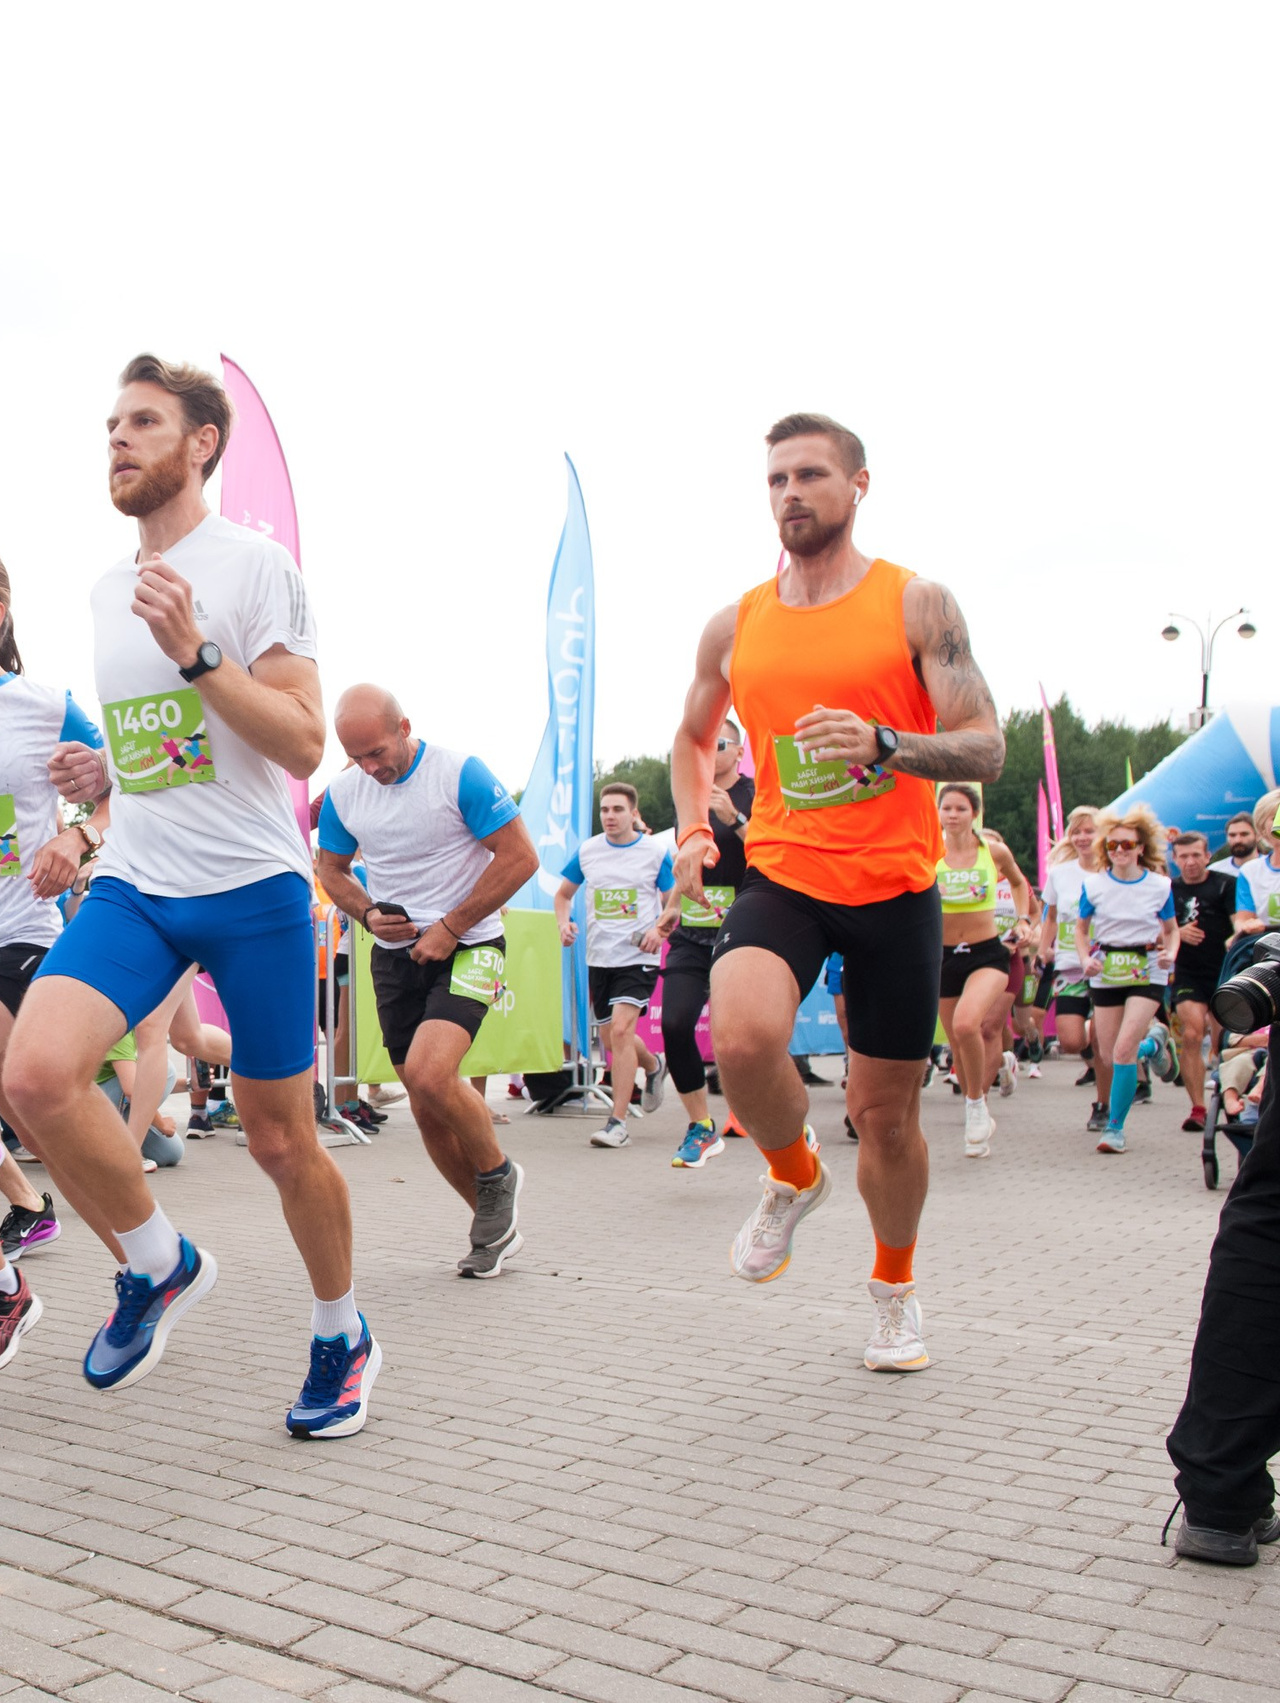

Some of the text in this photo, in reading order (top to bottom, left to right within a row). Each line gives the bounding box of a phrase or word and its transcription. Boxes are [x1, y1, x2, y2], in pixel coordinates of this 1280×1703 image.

[112, 699, 182, 737] 1460
[944, 870, 980, 884] 1296
[600, 890, 629, 902] 1243
[704, 889, 726, 903] 64
[471, 949, 504, 975] 1310
[1111, 954, 1141, 966] 1014
